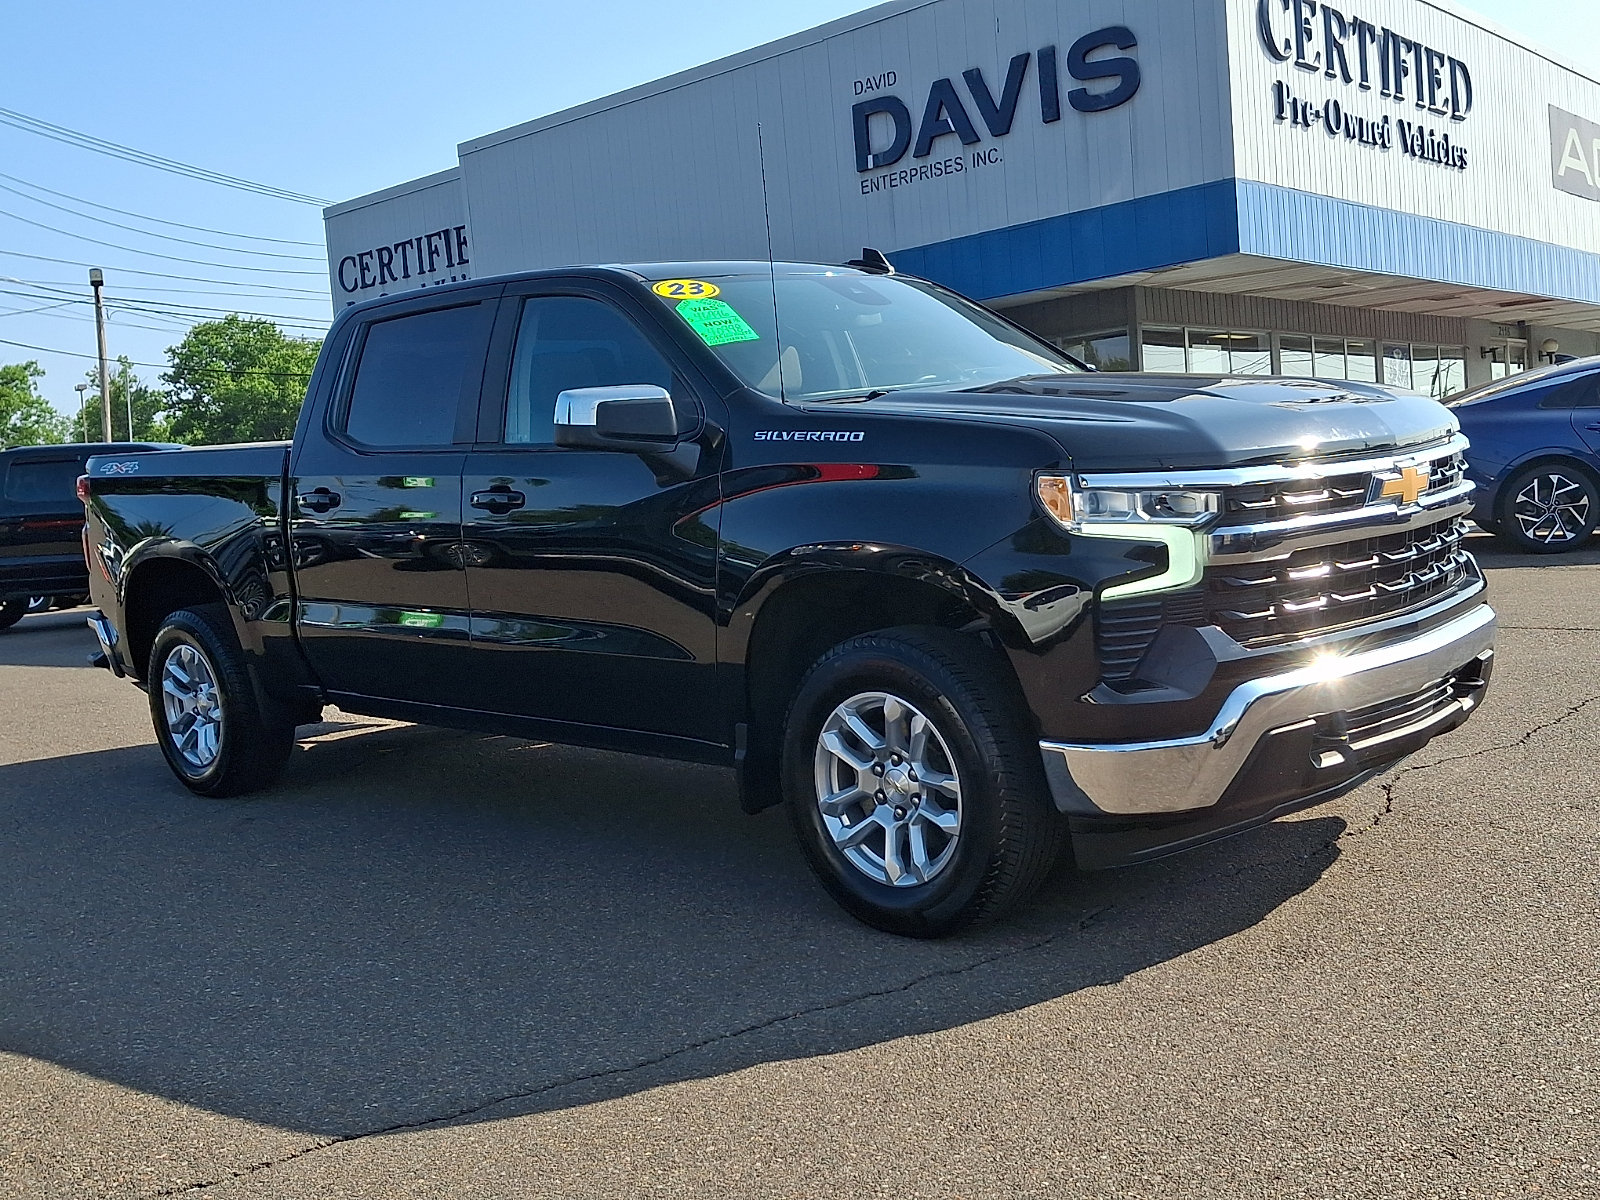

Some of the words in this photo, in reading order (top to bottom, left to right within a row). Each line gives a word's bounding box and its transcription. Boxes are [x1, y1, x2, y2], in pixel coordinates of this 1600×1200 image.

[853, 71, 897, 96] DAVID
[1257, 0, 1473, 122] CERTIFIED
[851, 26, 1141, 173] DAVIS
[1272, 80, 1393, 151] Pre-Owned
[1396, 118, 1468, 171] Vehicles
[860, 157, 968, 195] ENTERPRISES,
[972, 148, 1003, 169] INC.
[1557, 127, 1600, 189] A
[667, 282, 705, 295] 23
[703, 319, 732, 327] NOW
[754, 431, 865, 442] SILVERADO
